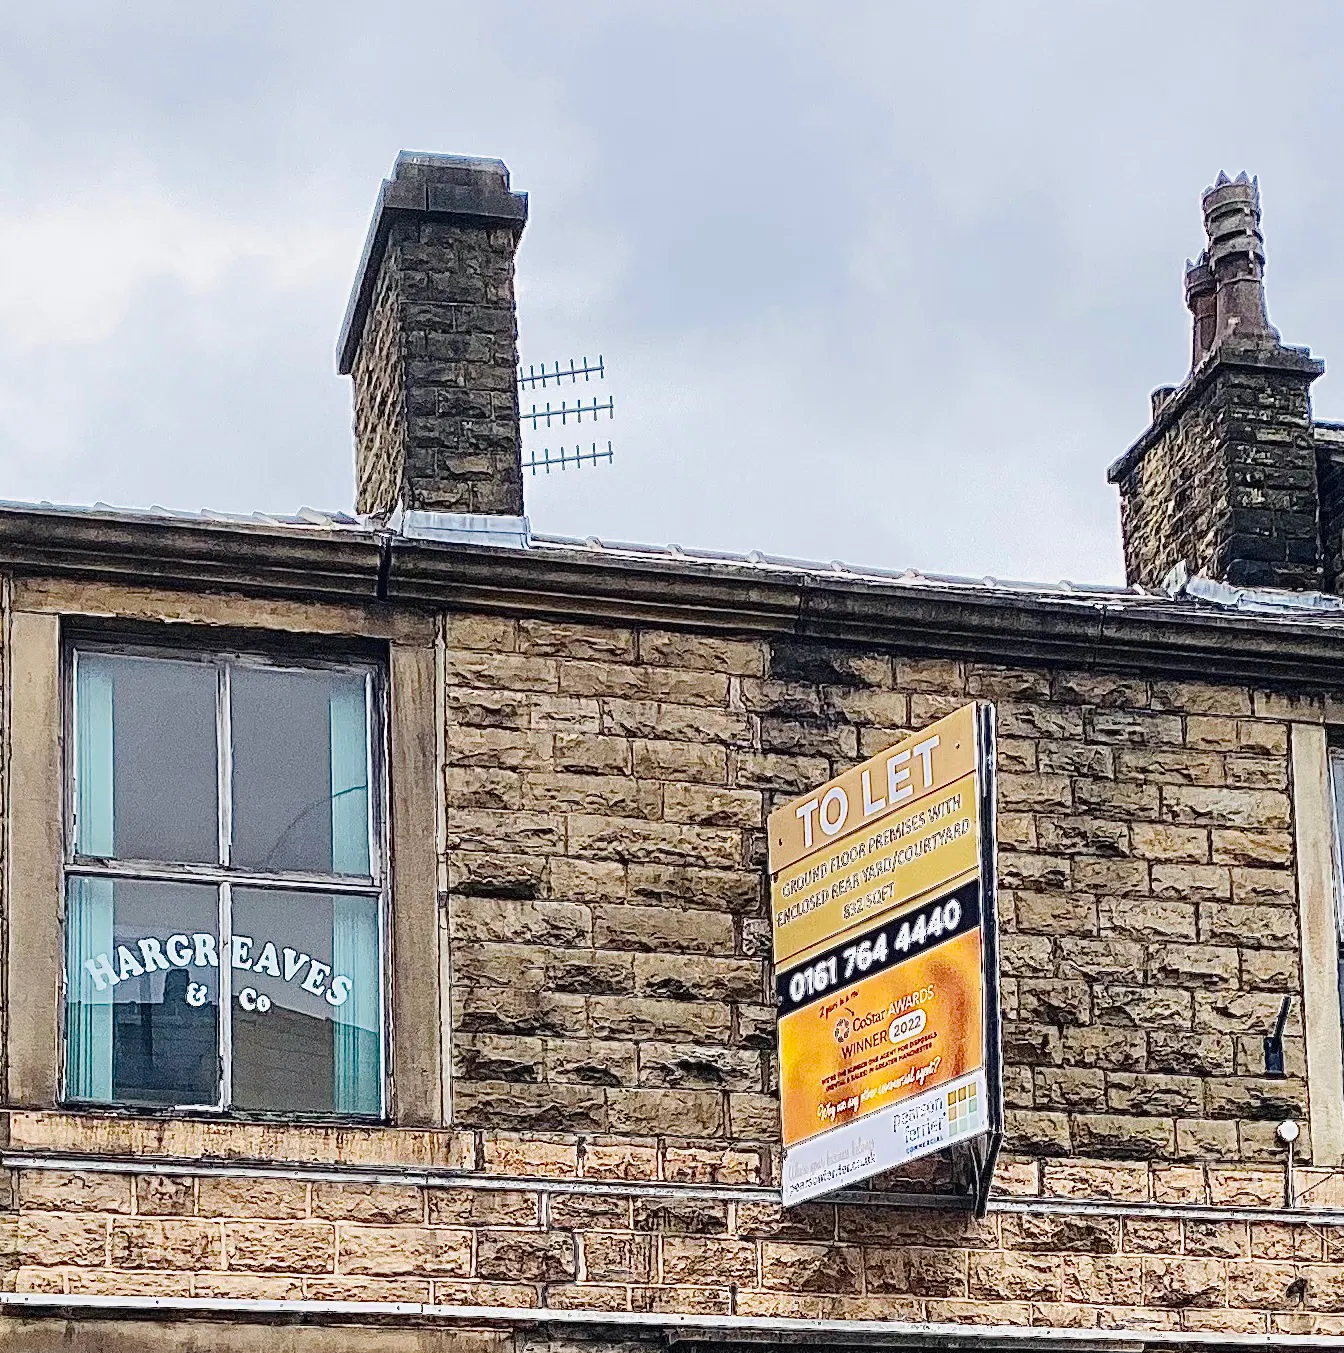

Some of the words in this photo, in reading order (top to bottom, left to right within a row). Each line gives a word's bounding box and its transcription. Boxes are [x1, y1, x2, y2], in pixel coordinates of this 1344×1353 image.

[796, 786, 848, 848] TO
[861, 735, 940, 817] LET
[776, 888, 830, 927] ENCLOSED
[831, 873, 860, 899] REAR
[861, 818, 970, 884] YARD/COURTYARD
[782, 863, 828, 898] GROUND
[830, 842, 866, 874] FLOOR
[868, 812, 925, 853] PREMISES
[928, 794, 962, 824] WITH
[84, 932, 353, 1006] HARGREAVES
[789, 956, 838, 1002] 0161
[843, 933, 889, 979] 764
[894, 898, 962, 952] 4440
[186, 982, 208, 1007] &
[239, 987, 271, 1013] Co
[853, 1010, 886, 1032] CoStar
[887, 984, 935, 1017] AWARDS
[841, 1029, 888, 1060] WINNER
[893, 1015, 921, 1038] 2022
[893, 1097, 943, 1133] pearson
